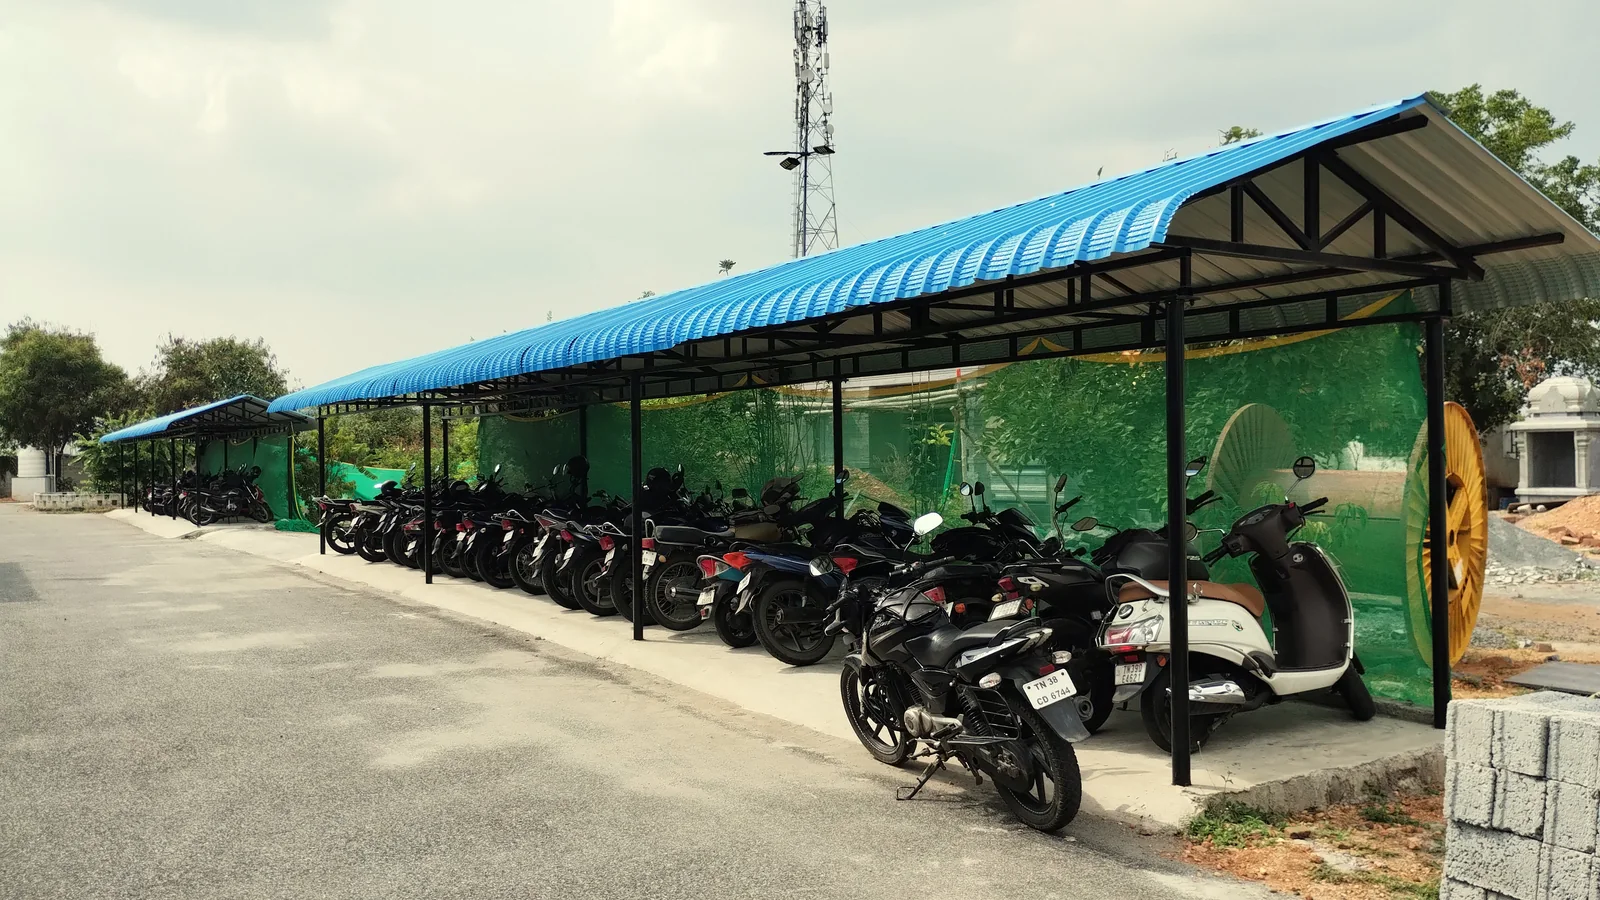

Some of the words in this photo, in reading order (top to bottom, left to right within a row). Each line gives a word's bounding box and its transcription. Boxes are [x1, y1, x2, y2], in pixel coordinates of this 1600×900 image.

[1034, 681, 1047, 690] TN
[1048, 676, 1058, 685] 38
[1037, 696, 1049, 705] CD
[1050, 687, 1070, 699] 6744
